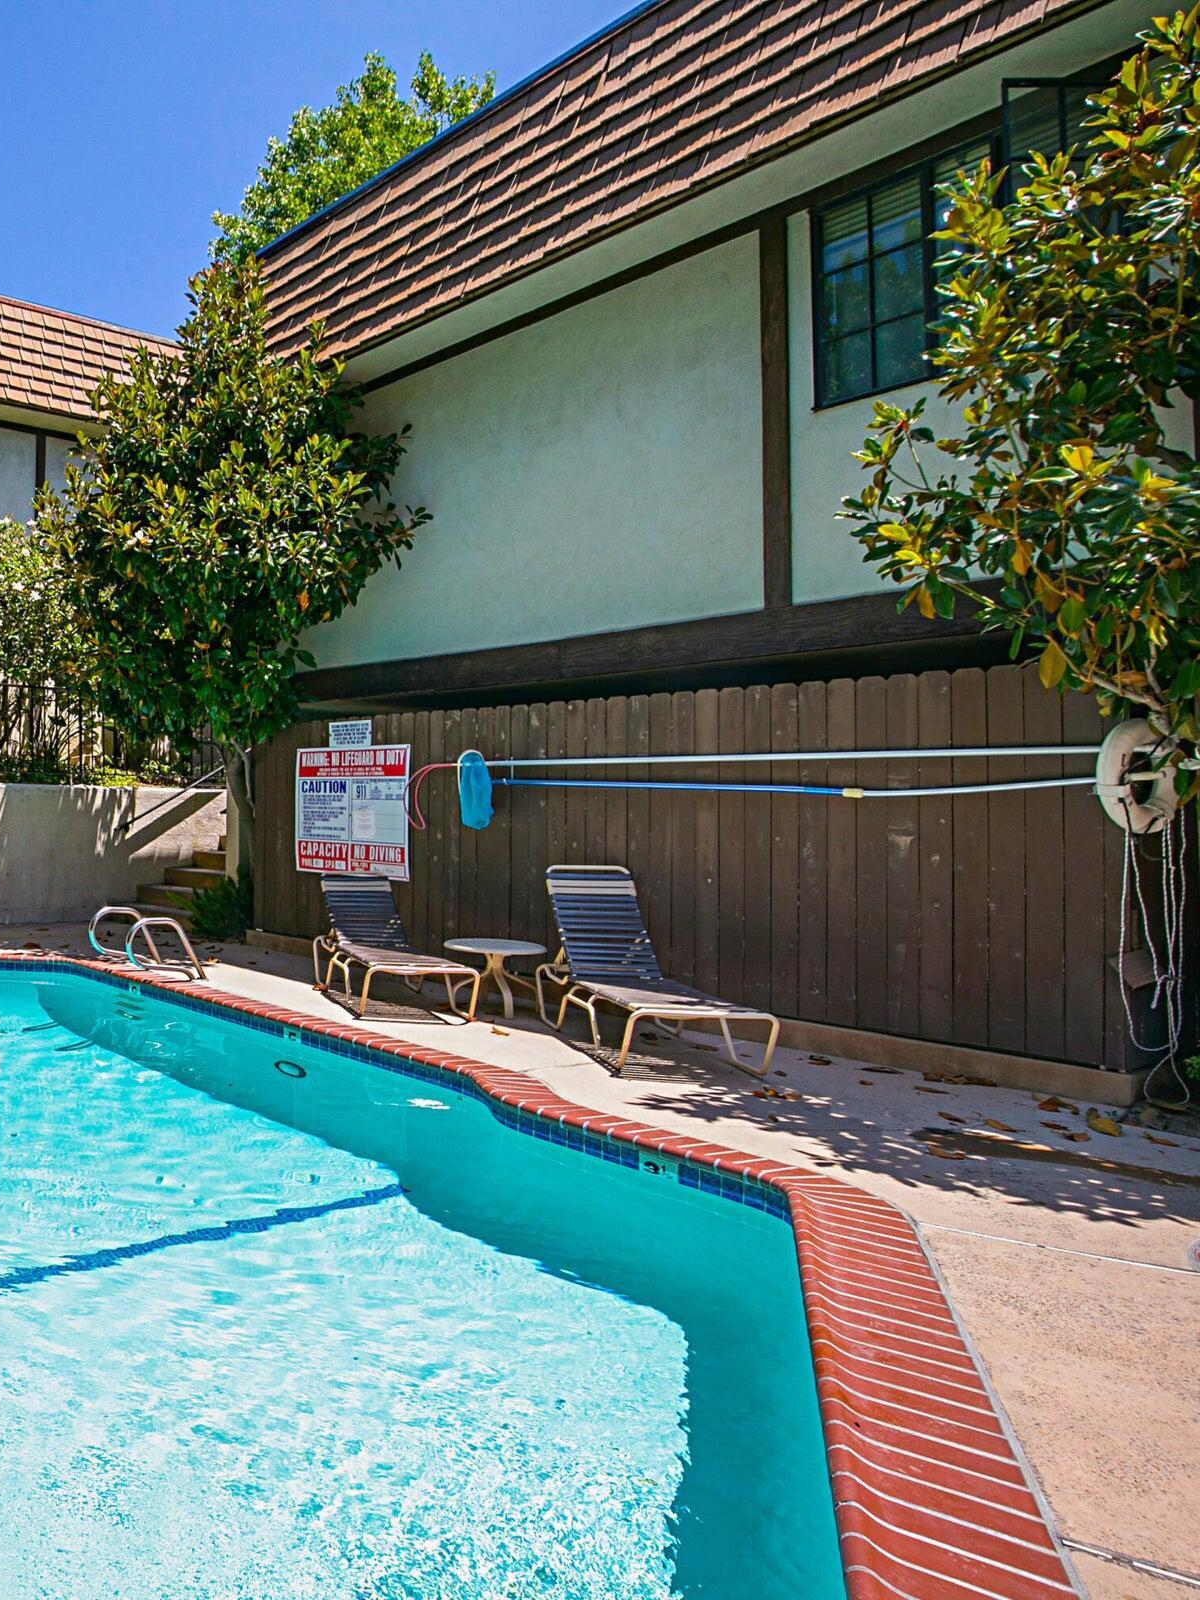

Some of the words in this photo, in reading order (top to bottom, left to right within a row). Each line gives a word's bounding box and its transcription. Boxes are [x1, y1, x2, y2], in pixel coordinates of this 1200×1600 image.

[331, 752, 340, 766] NO
[341, 751, 374, 766] LIFEGUARD
[376, 750, 385, 766] ON
[386, 749, 405, 766] DUTY
[301, 780, 347, 794] CAUTION
[356, 785, 367, 799] 911
[300, 841, 348, 859] CAPACITY
[354, 844, 366, 860] NO
[369, 846, 402, 862] DIVING
[301, 857, 313, 867] POOL
[324, 859, 335, 869] SPA
